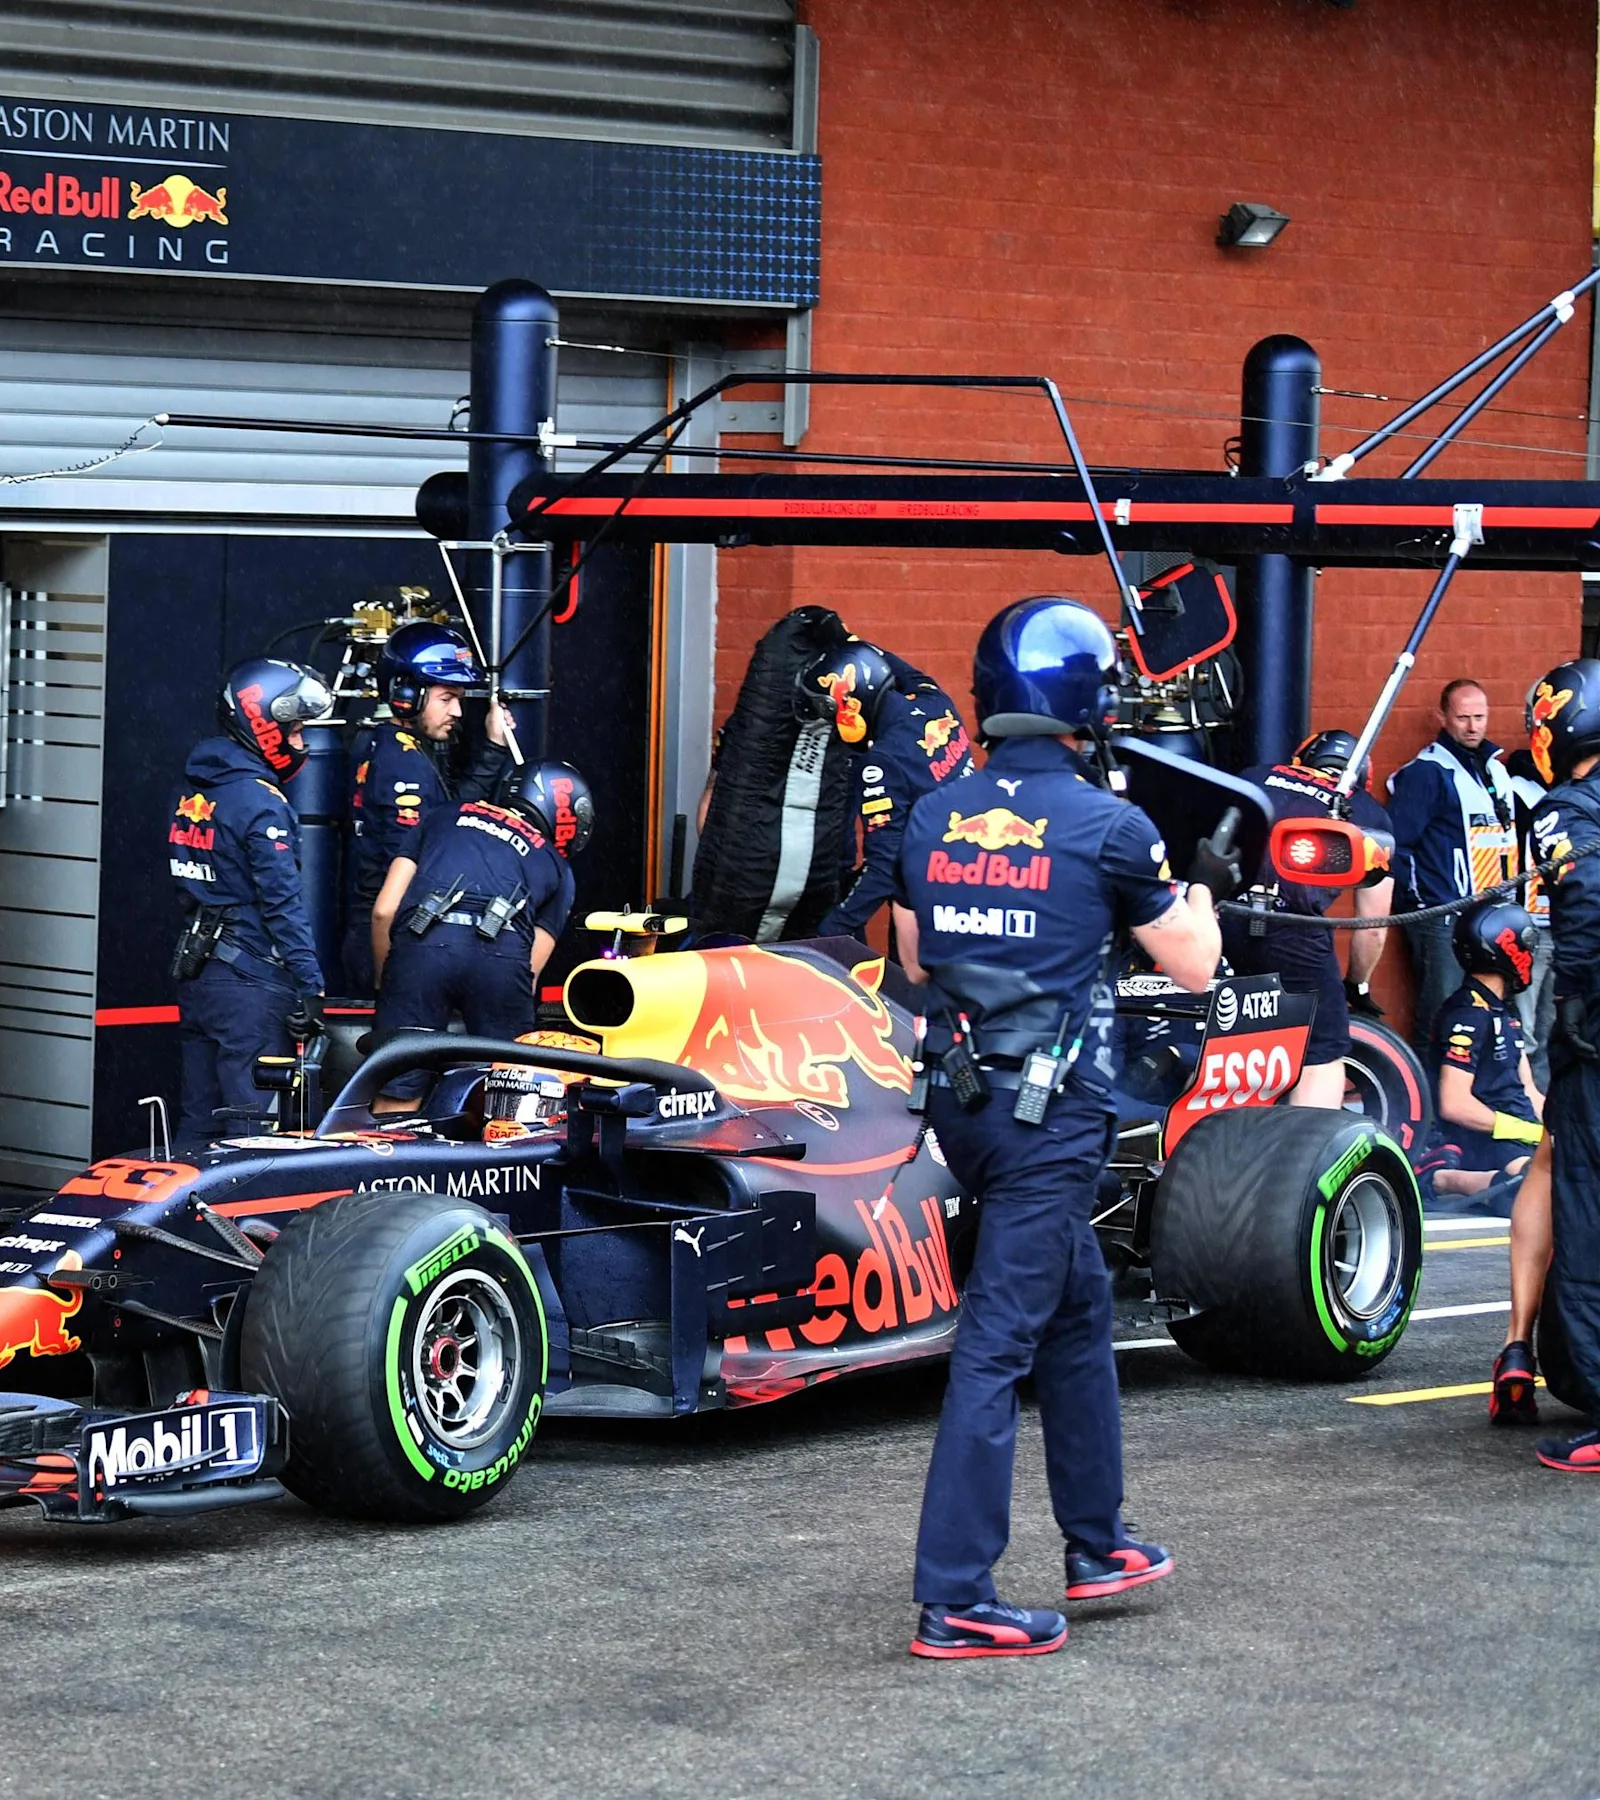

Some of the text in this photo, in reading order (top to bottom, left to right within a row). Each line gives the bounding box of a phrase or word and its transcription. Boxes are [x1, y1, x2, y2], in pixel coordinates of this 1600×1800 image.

[107, 114, 230, 152] MARTIN
[926, 850, 1051, 891] Red Bull
[933, 904, 1005, 937] Mobil
[1242, 989, 1281, 1020] AT&T
[505, 1080, 540, 1092] MARTIN
[1186, 1045, 1292, 1111] ESSO
[57, 1158, 202, 1203] 33
[447, 1164, 541, 1198] MARTIN
[404, 1222, 480, 1297] PIRELLI
[724, 1196, 959, 1354] ed Bull
[88, 1413, 202, 1489] Mobil
